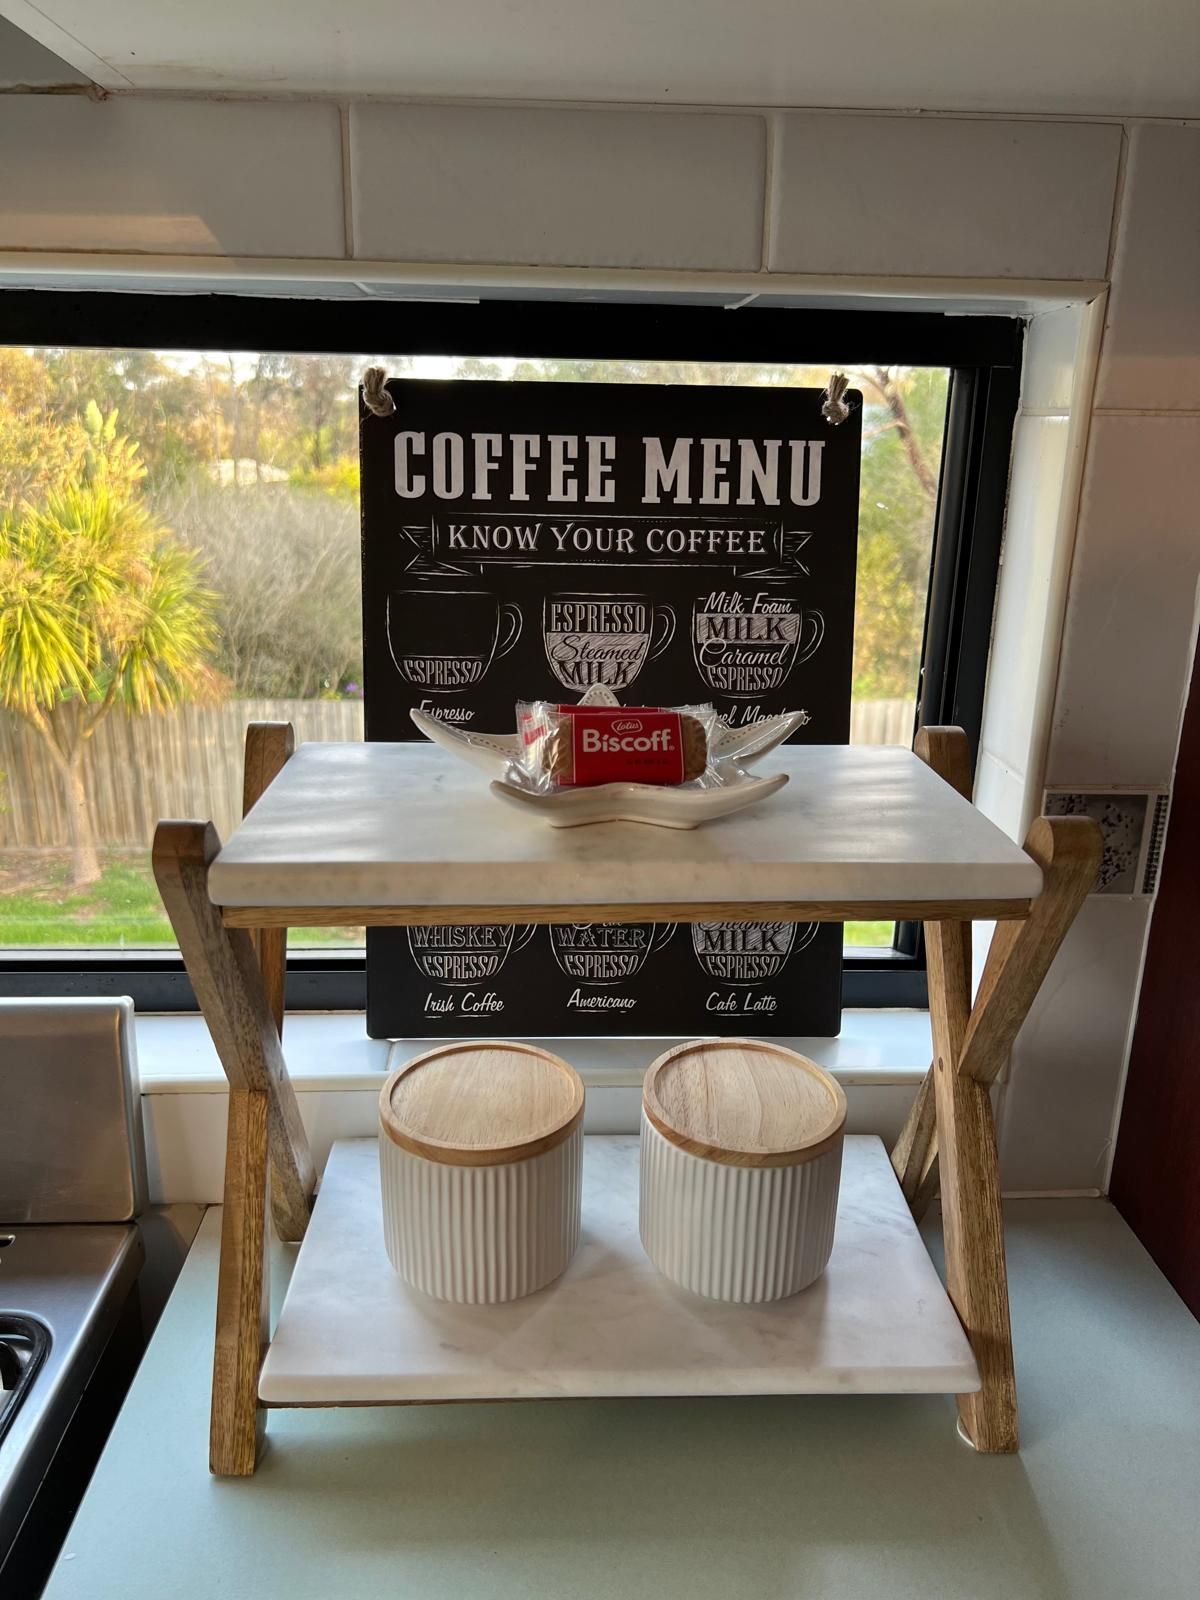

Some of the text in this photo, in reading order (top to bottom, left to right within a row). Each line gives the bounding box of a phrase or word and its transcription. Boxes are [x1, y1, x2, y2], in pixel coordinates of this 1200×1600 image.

[394, 431, 826, 506] COFFEE MENU
[448, 522, 767, 554] KNOW YOUR COFFEE
[704, 592, 792, 614] Milk Foam
[551, 603, 646, 633] ESPRESSO
[705, 616, 789, 640] MILK
[550, 635, 646, 662] Steamed
[700, 638, 791, 667] Caramel
[404, 659, 483, 685] ESPRESSO
[557, 661, 636, 685] MILK
[706, 666, 784, 691] ESPRESSO
[616, 721, 640, 731] Lotus
[582, 728, 672, 753] Biscoff
[412, 925, 509, 948] WHISKEY
[555, 927, 647, 949] WATER
[702, 930, 784, 951] MILK
[421, 955, 499, 979] ESPRESSO
[563, 954, 639, 978] ESPRESSO
[705, 955, 781, 979] ESPRESSO
[423, 991, 505, 1013] Irish Coffee
[566, 988, 638, 1009] Americano
[705, 991, 778, 1012] Cafe Latte
